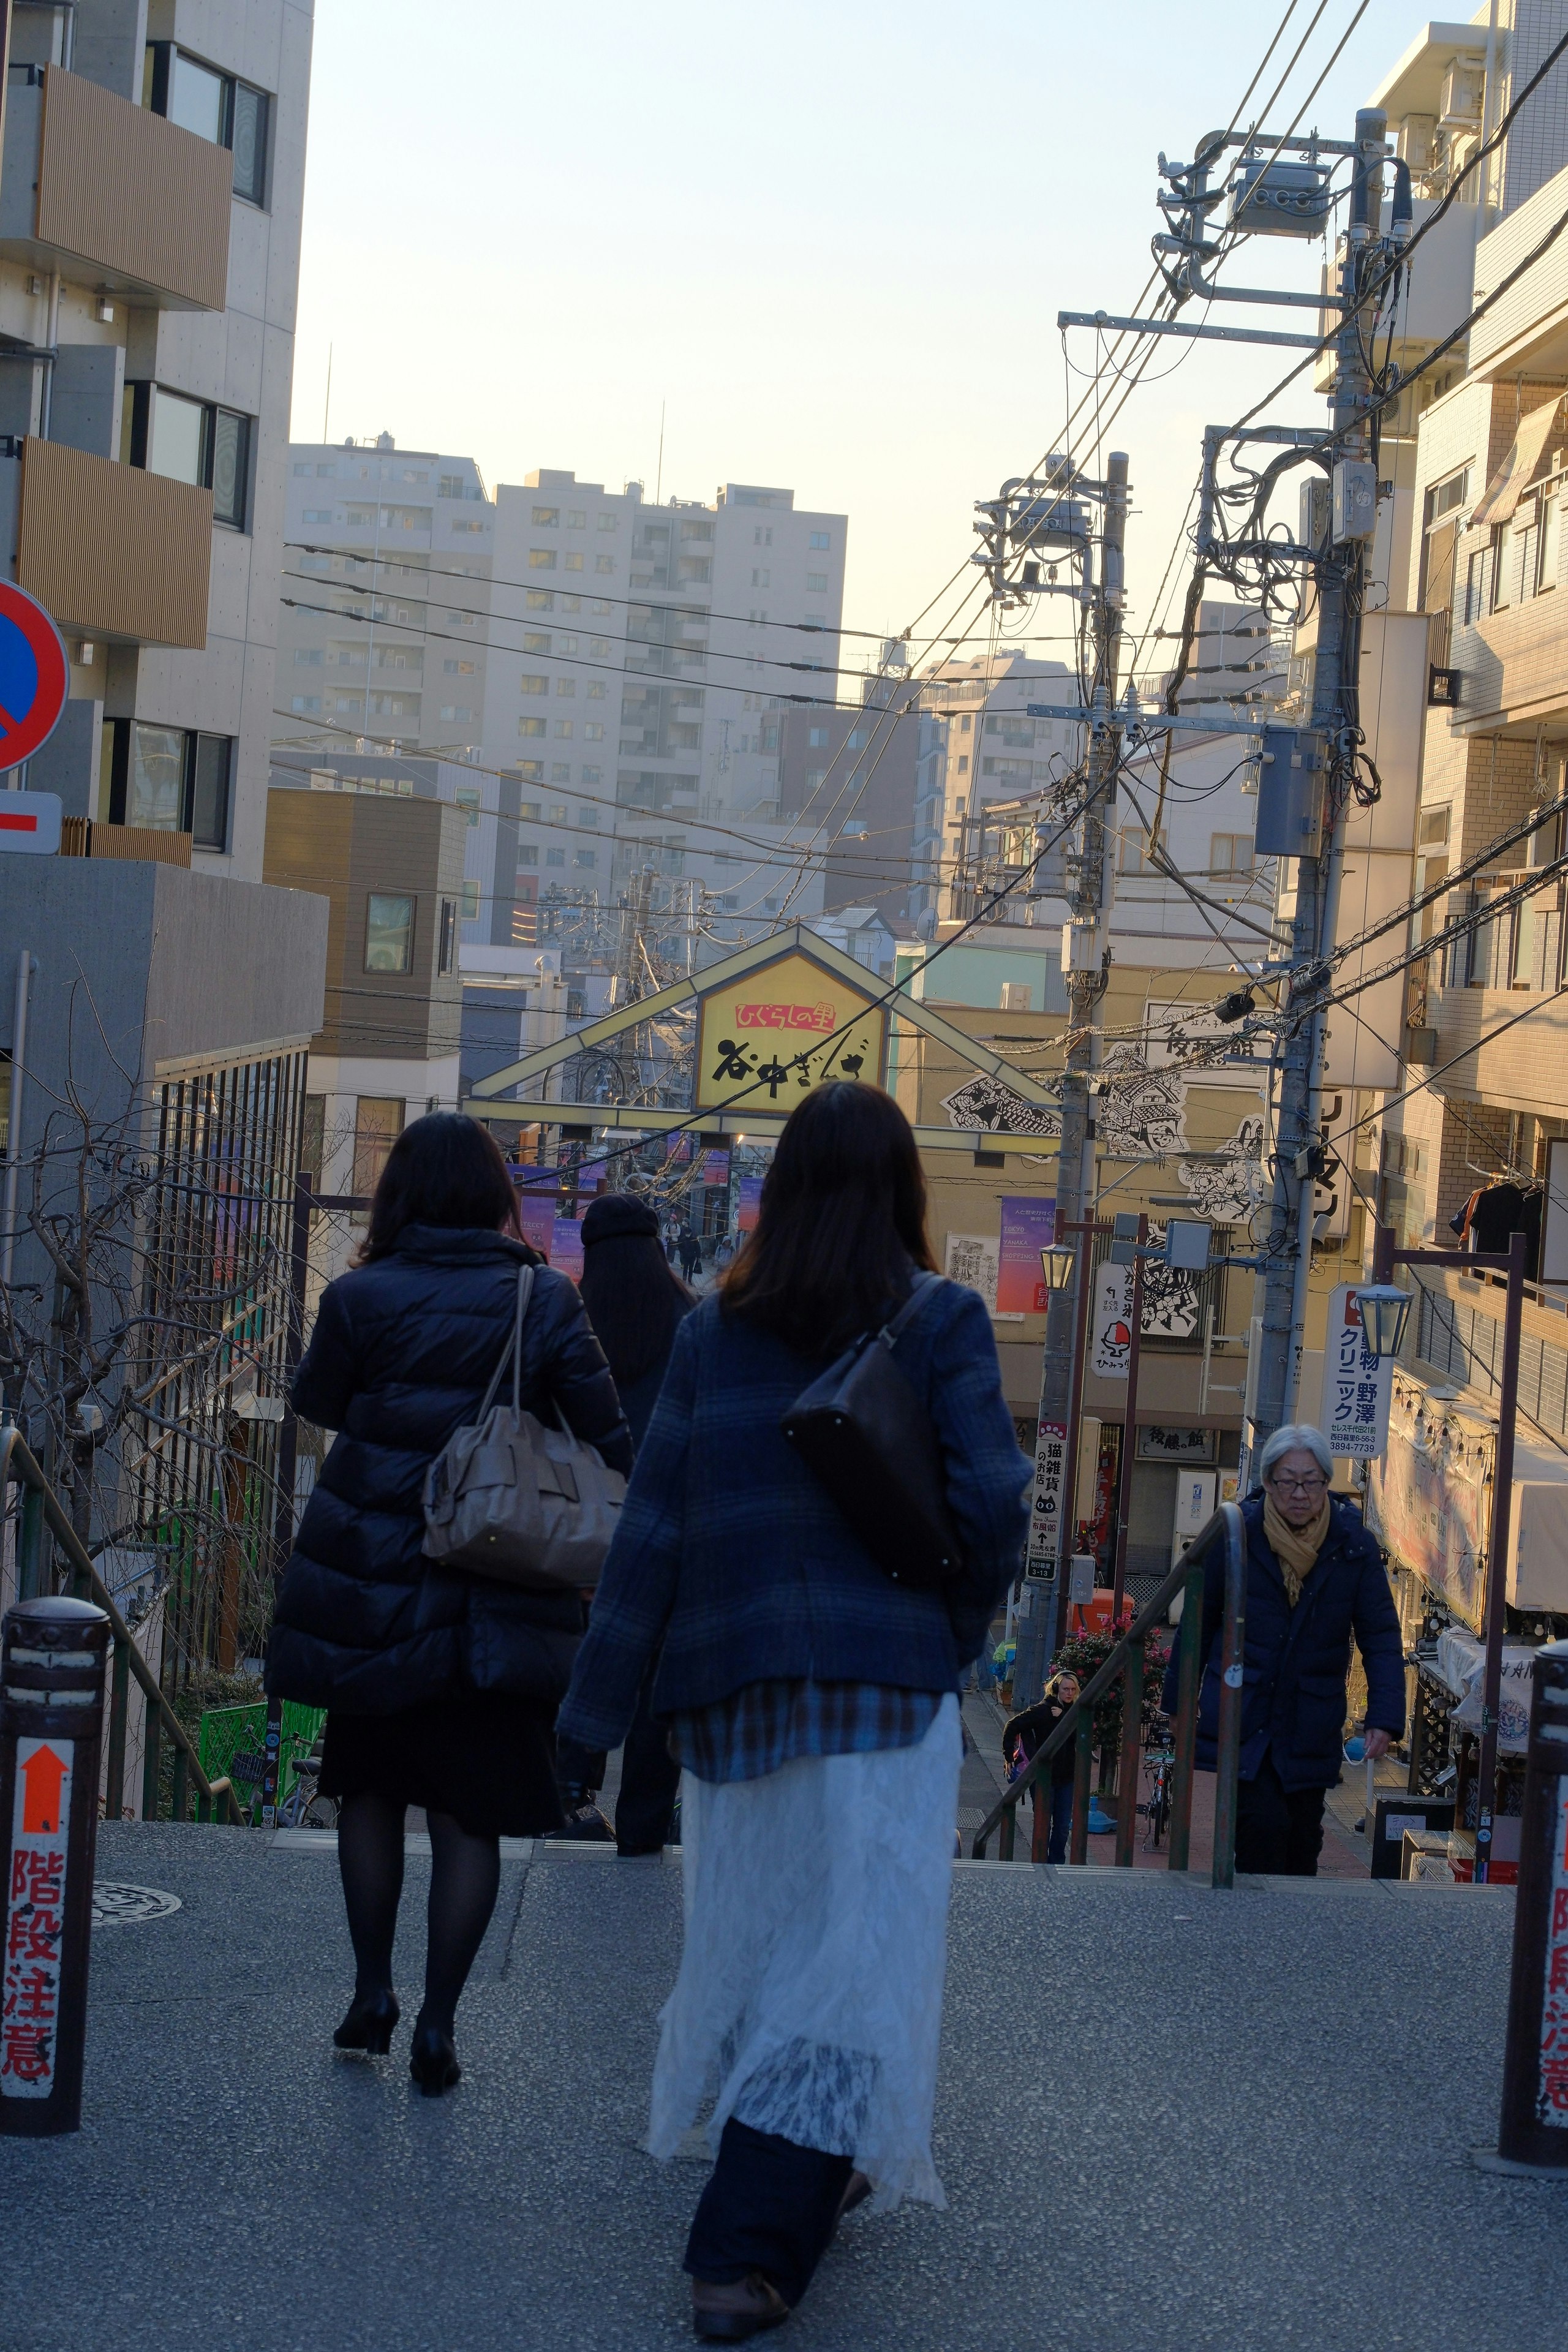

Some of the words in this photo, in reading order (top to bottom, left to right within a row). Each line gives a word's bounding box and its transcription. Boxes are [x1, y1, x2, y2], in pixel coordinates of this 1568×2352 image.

[737, 1002, 835, 1034] ひぐらしの里
[1335, 1328, 1359, 1420] クリニック
[1148, 1425, 1205, 1451] 後藤の飴
[1330, 1434, 1376, 1443] 西日暮里6-56-3
[1331, 1424, 1376, 1434] セレス千代田21前
[1330, 1442, 1375, 1452] 3894-7739
[1036, 1451, 1046, 1485] のお店
[1046, 1443, 1062, 1493] 猫雑貨
[1, 1850, 64, 2077] 階段注意
